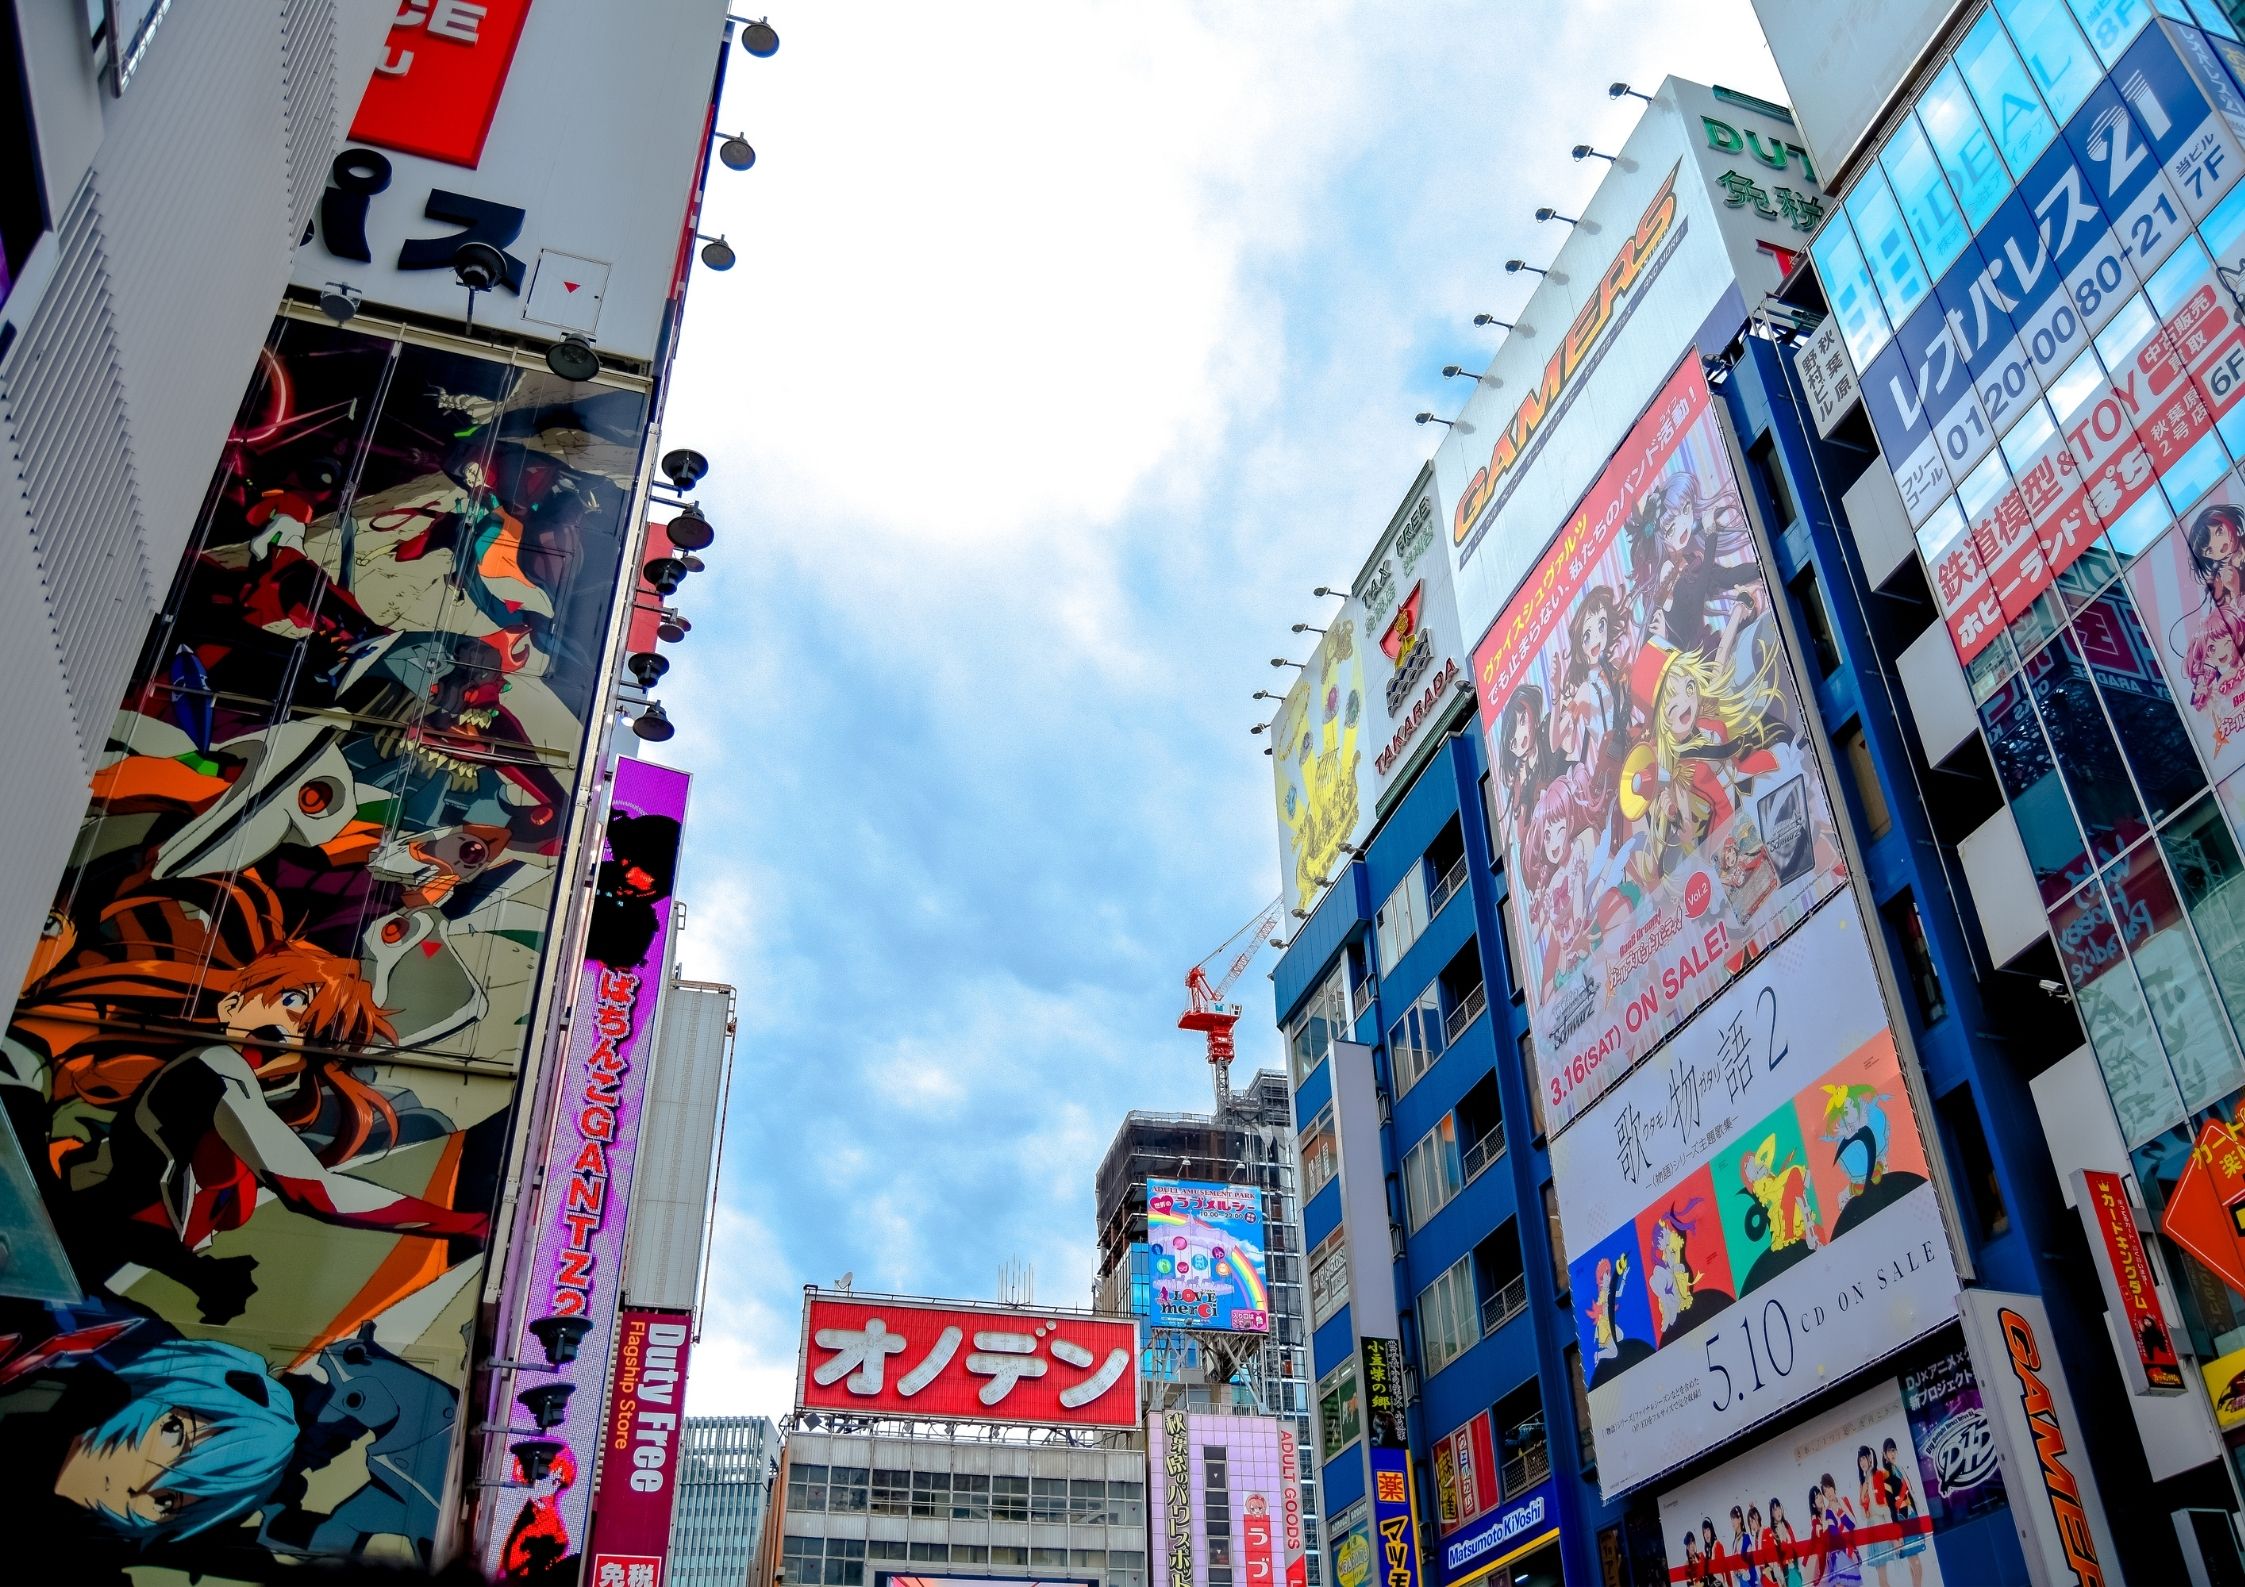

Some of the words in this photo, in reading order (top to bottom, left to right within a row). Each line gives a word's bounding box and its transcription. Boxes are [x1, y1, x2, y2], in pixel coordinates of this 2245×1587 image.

[2176, 133, 2214, 178] 当ビル
[2183, 144, 2225, 200] 7F
[1454, 153, 1684, 548] GAMERS
[2144, 292, 2210, 365] 中古販売
[1802, 348, 1834, 423] 野村ビル
[1817, 329, 1852, 403] 秋葉原
[2210, 347, 2245, 397] 6F
[1901, 455, 1936, 495] フリー
[1936, 455, 2065, 607] 鉄道模型
[2067, 369, 2143, 462] TOY
[1360, 558, 1393, 611] TAX
[1395, 494, 1432, 559] FREE
[1957, 508, 2082, 648] ホビーランド
[1374, 655, 1460, 777] TAKARADA
[1687, 883, 1709, 907] Vol.2
[1550, 1023, 1622, 1106] 3.16(SAT)
[1625, 986, 1660, 1034] ON
[1661, 920, 1730, 1000] SALE!
[1181, 1187, 1233, 1198] AMUSEMENT
[1234, 1191, 1256, 1200] PARK
[619, 1321, 645, 1394] Flagship
[812, 1317, 1130, 1408] オノデン
[1706, 1299, 1795, 1413] 5.10
[1801, 1306, 1826, 1335] CD
[1838, 1280, 1866, 1313] ON
[1877, 1240, 1936, 1292] SALE
[637, 1323, 687, 1405] Duty
[615, 1399, 636, 1449] Store
[630, 1411, 677, 1492] Free
[1280, 1430, 1297, 1483] ADULT
[1284, 1487, 1301, 1550] GOODS
[1379, 1473, 1404, 1501] 薬
[599, 1562, 655, 1587] 免税
[1247, 1527, 1270, 1578] ラブ
[1449, 1530, 1503, 1567] Matsumoto
